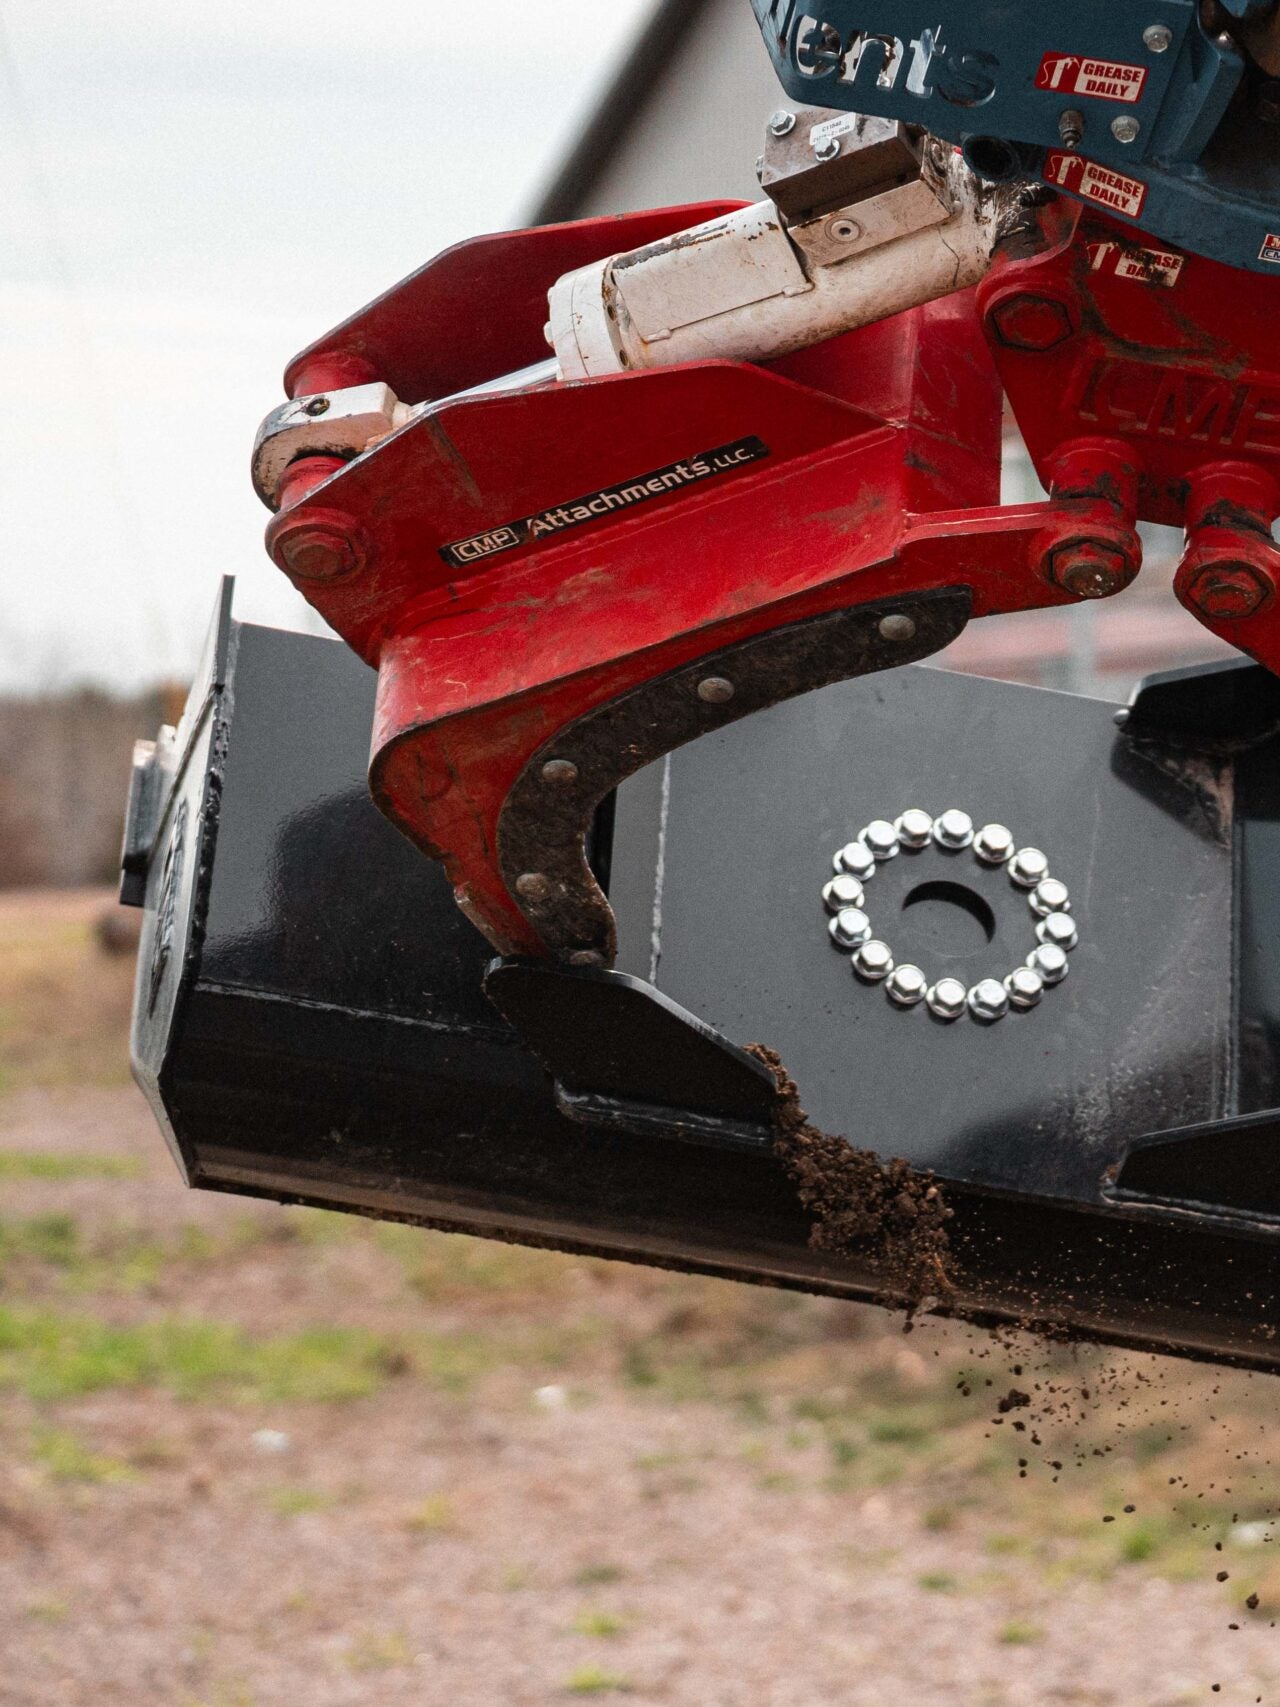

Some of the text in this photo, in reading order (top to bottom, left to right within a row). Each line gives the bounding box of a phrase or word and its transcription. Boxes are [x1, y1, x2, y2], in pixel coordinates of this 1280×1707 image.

[1083, 62, 1141, 83] GREASE
[1085, 81, 1131, 97] DAILY
[1087, 166, 1142, 198] GREASE
[1089, 183, 1131, 209] DAILY
[1125, 249, 1182, 270] ASE
[458, 448, 755, 559] CMP Attachments, LLC.
